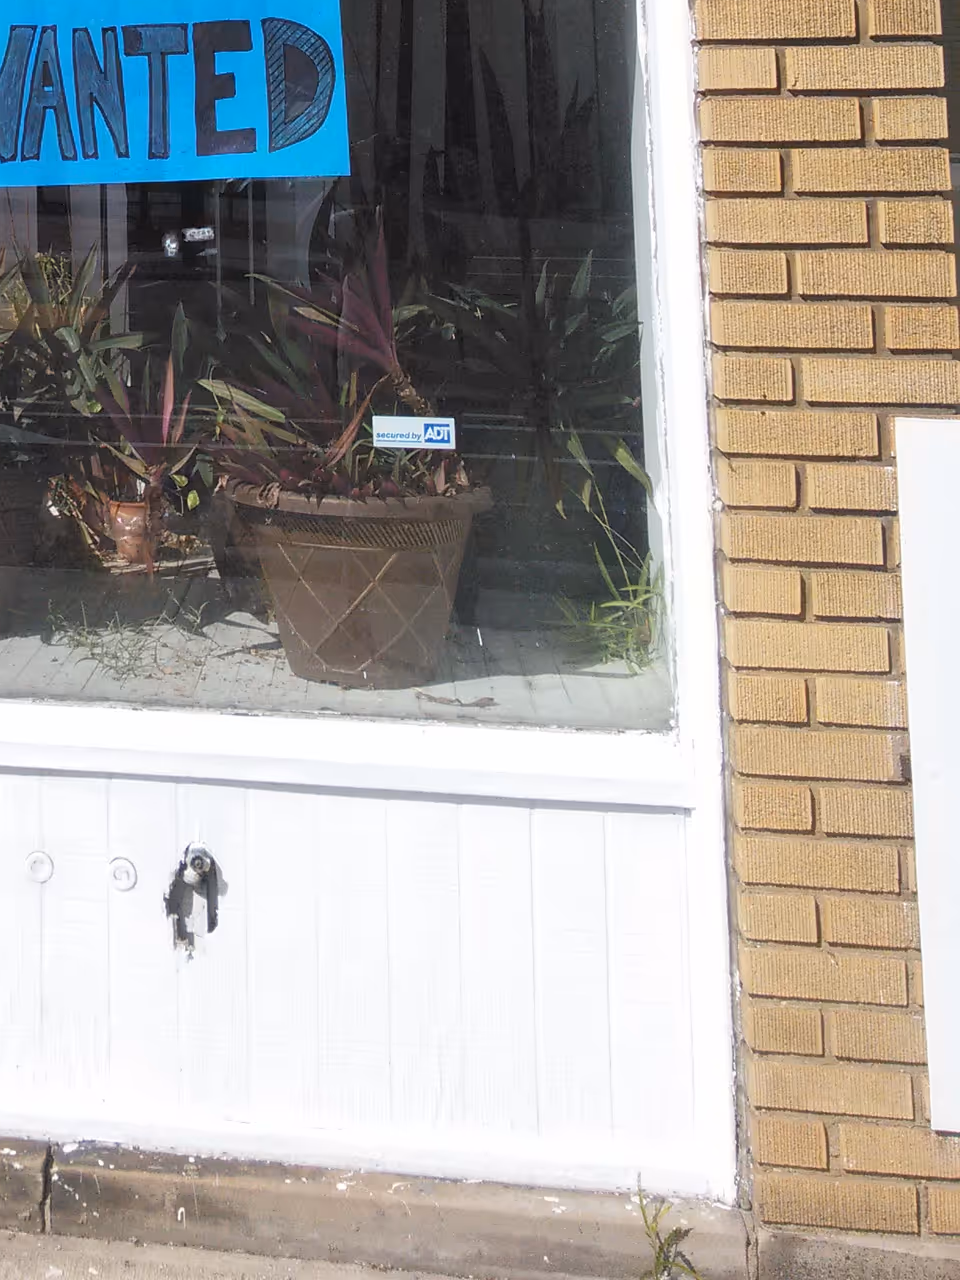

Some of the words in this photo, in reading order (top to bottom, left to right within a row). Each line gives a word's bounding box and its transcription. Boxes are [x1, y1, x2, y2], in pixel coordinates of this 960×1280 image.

[375, 431, 411, 439] secured
[411, 432, 422, 441] by
[424, 425, 450, 441] ADT
